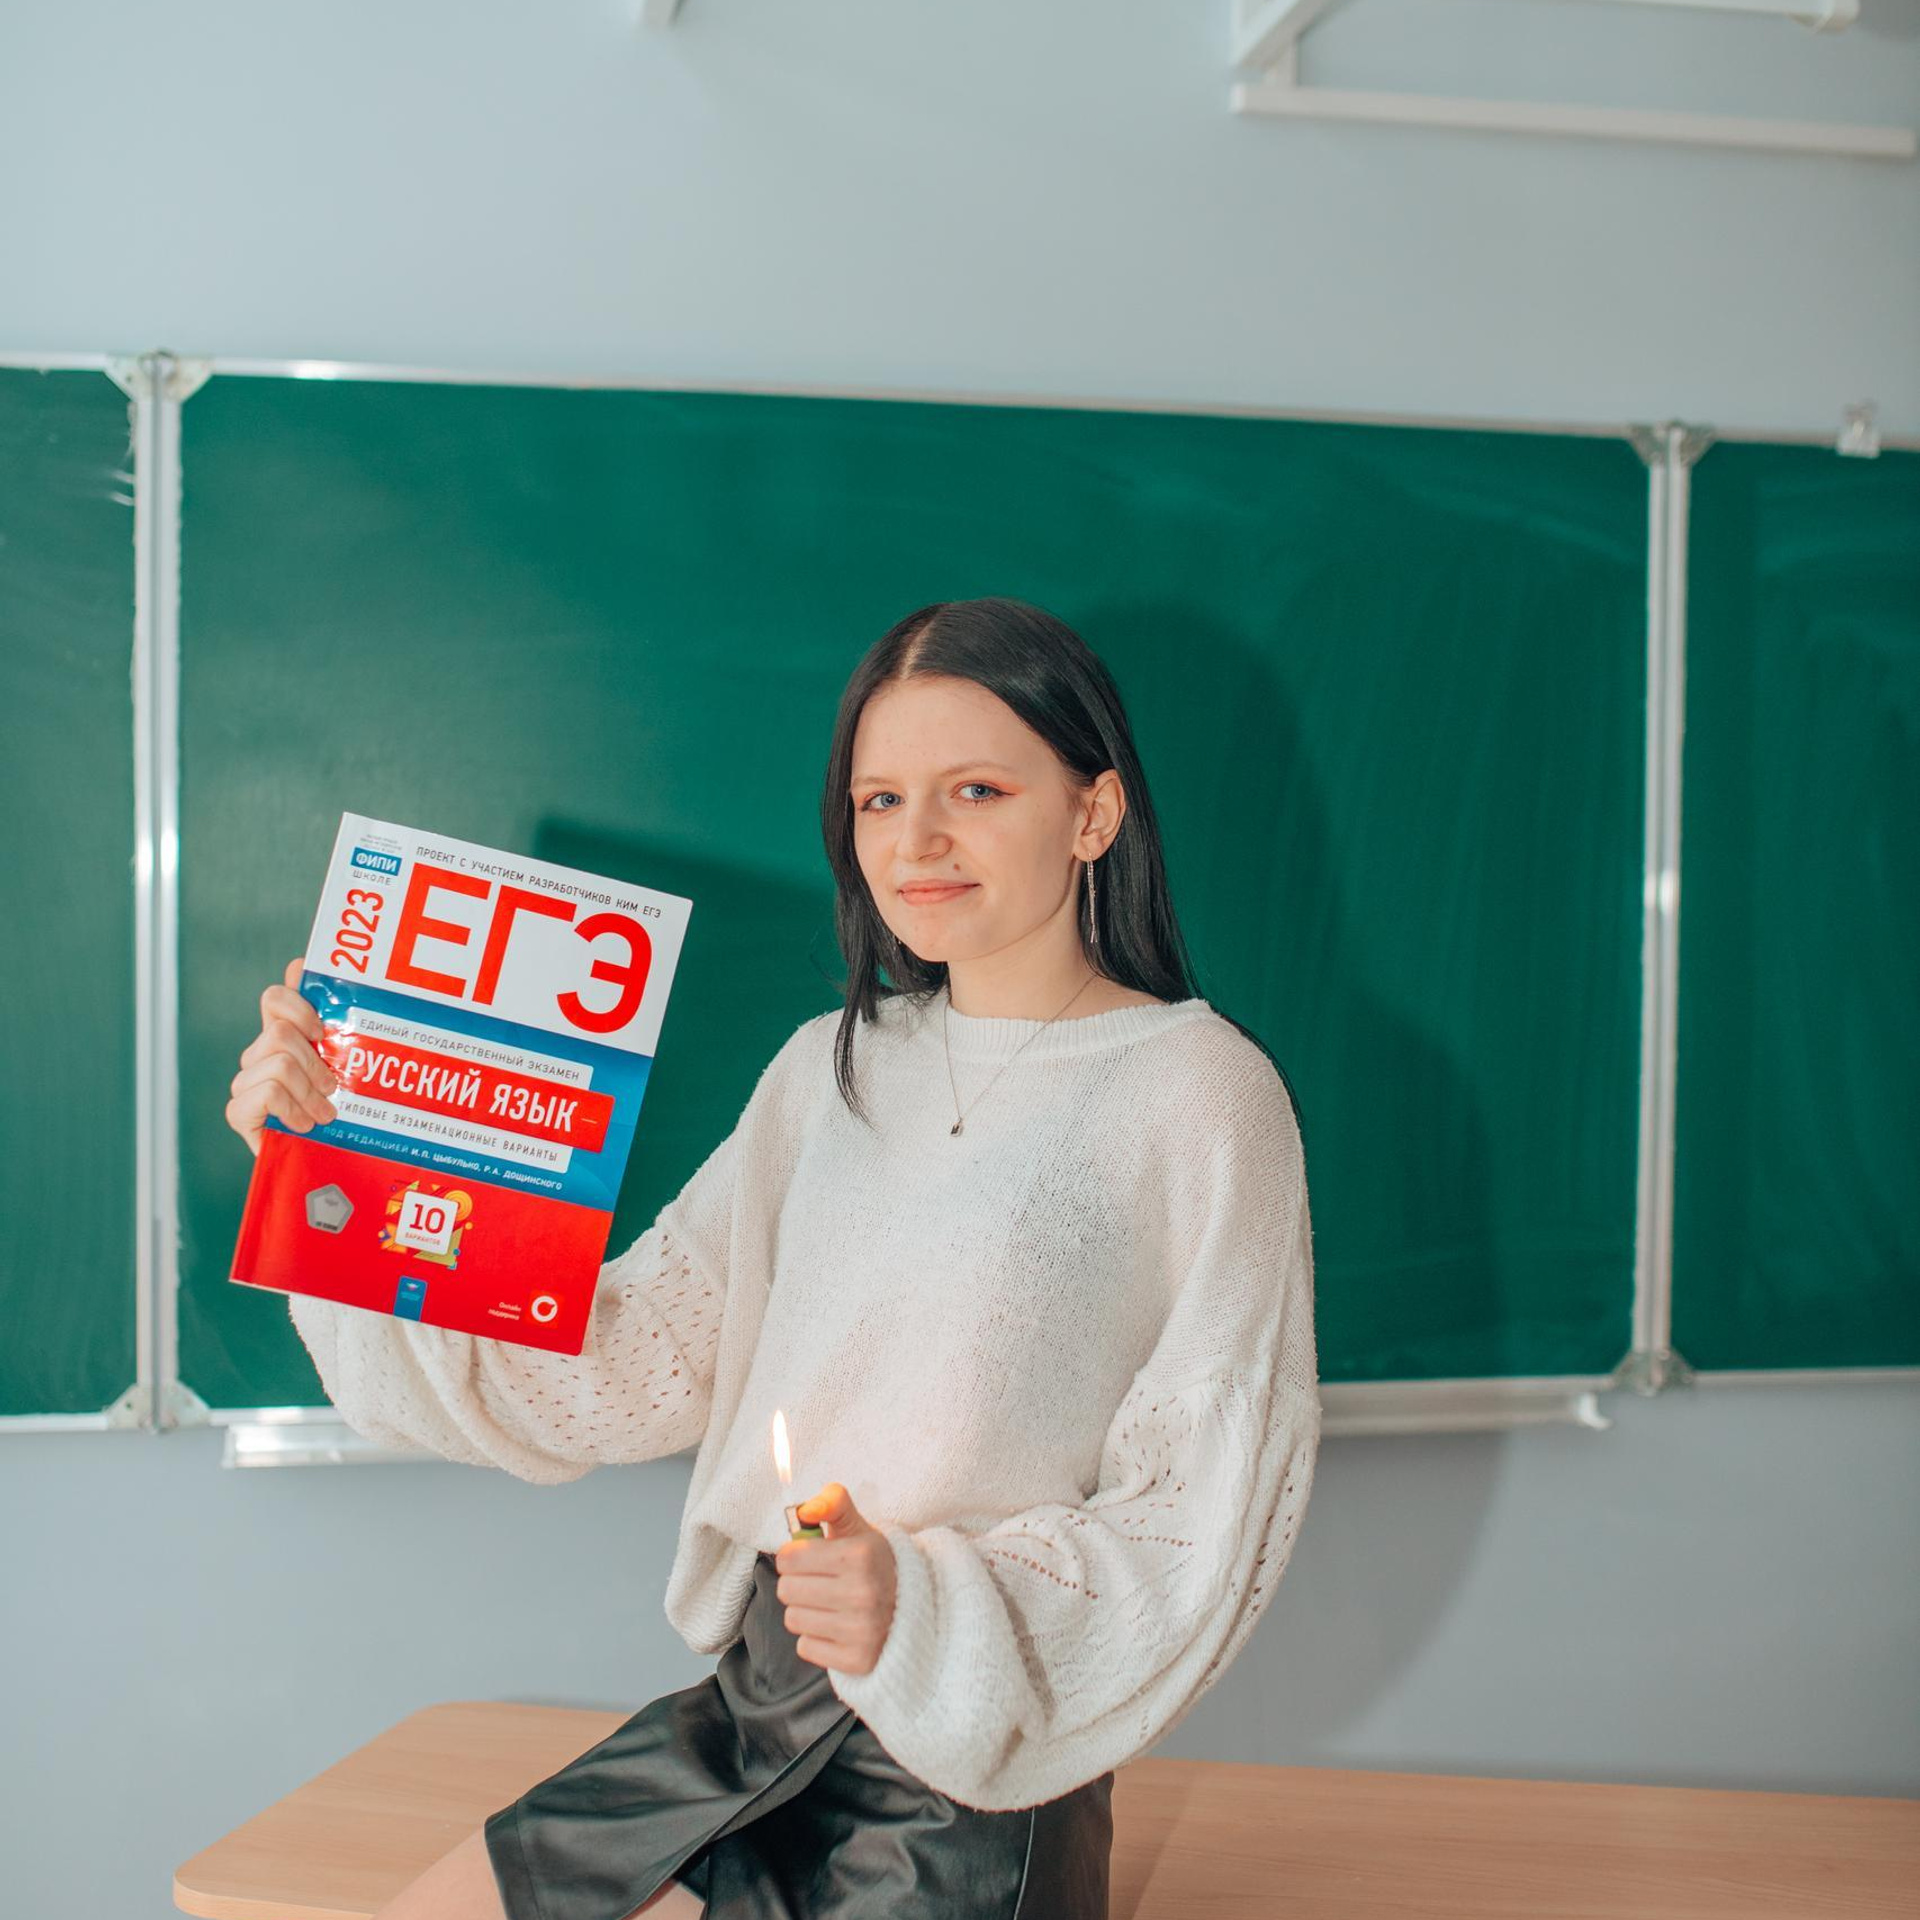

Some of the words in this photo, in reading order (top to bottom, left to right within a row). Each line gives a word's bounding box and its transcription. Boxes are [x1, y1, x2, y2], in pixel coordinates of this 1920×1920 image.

[353, 870, 392, 885] ШКОЛЕ
[356, 852, 397, 872] ФИПИ
[416, 846, 456, 864] ПРОЕКТ
[460, 857, 467, 868] С
[471, 860, 524, 883] УЧАСТИЕМ
[529, 875, 612, 905] РАЗРАБОТЧИКОВ
[616, 898, 639, 913] КИМ
[643, 905, 662, 919] ЕГЭ
[331, 888, 384, 974] 2023
[385, 862, 652, 1033] ЕГЭ
[360, 1018, 409, 1038] ЕДИНЫЙ
[413, 1031, 523, 1066] ГОСУДАРСТВЕННЫЙ
[528, 1060, 580, 1080] ЭКЗАМЕН
[344, 1046, 482, 1109] РУССКИЙ
[488, 1083, 578, 1132] ЯЗЫК
[347, 1132, 409, 1153] РЕДАКЦИЕЙ
[432, 1153, 480, 1172] ЦЫБУЛЬКО,
[502, 1170, 563, 1190] ДОЩИНСКОГО
[393, 1113, 497, 1147] ЭКЗАМЕНАЦИОННЫЕ
[503, 1140, 558, 1162] ВАРИАНТЫ
[409, 1203, 445, 1234] 10
